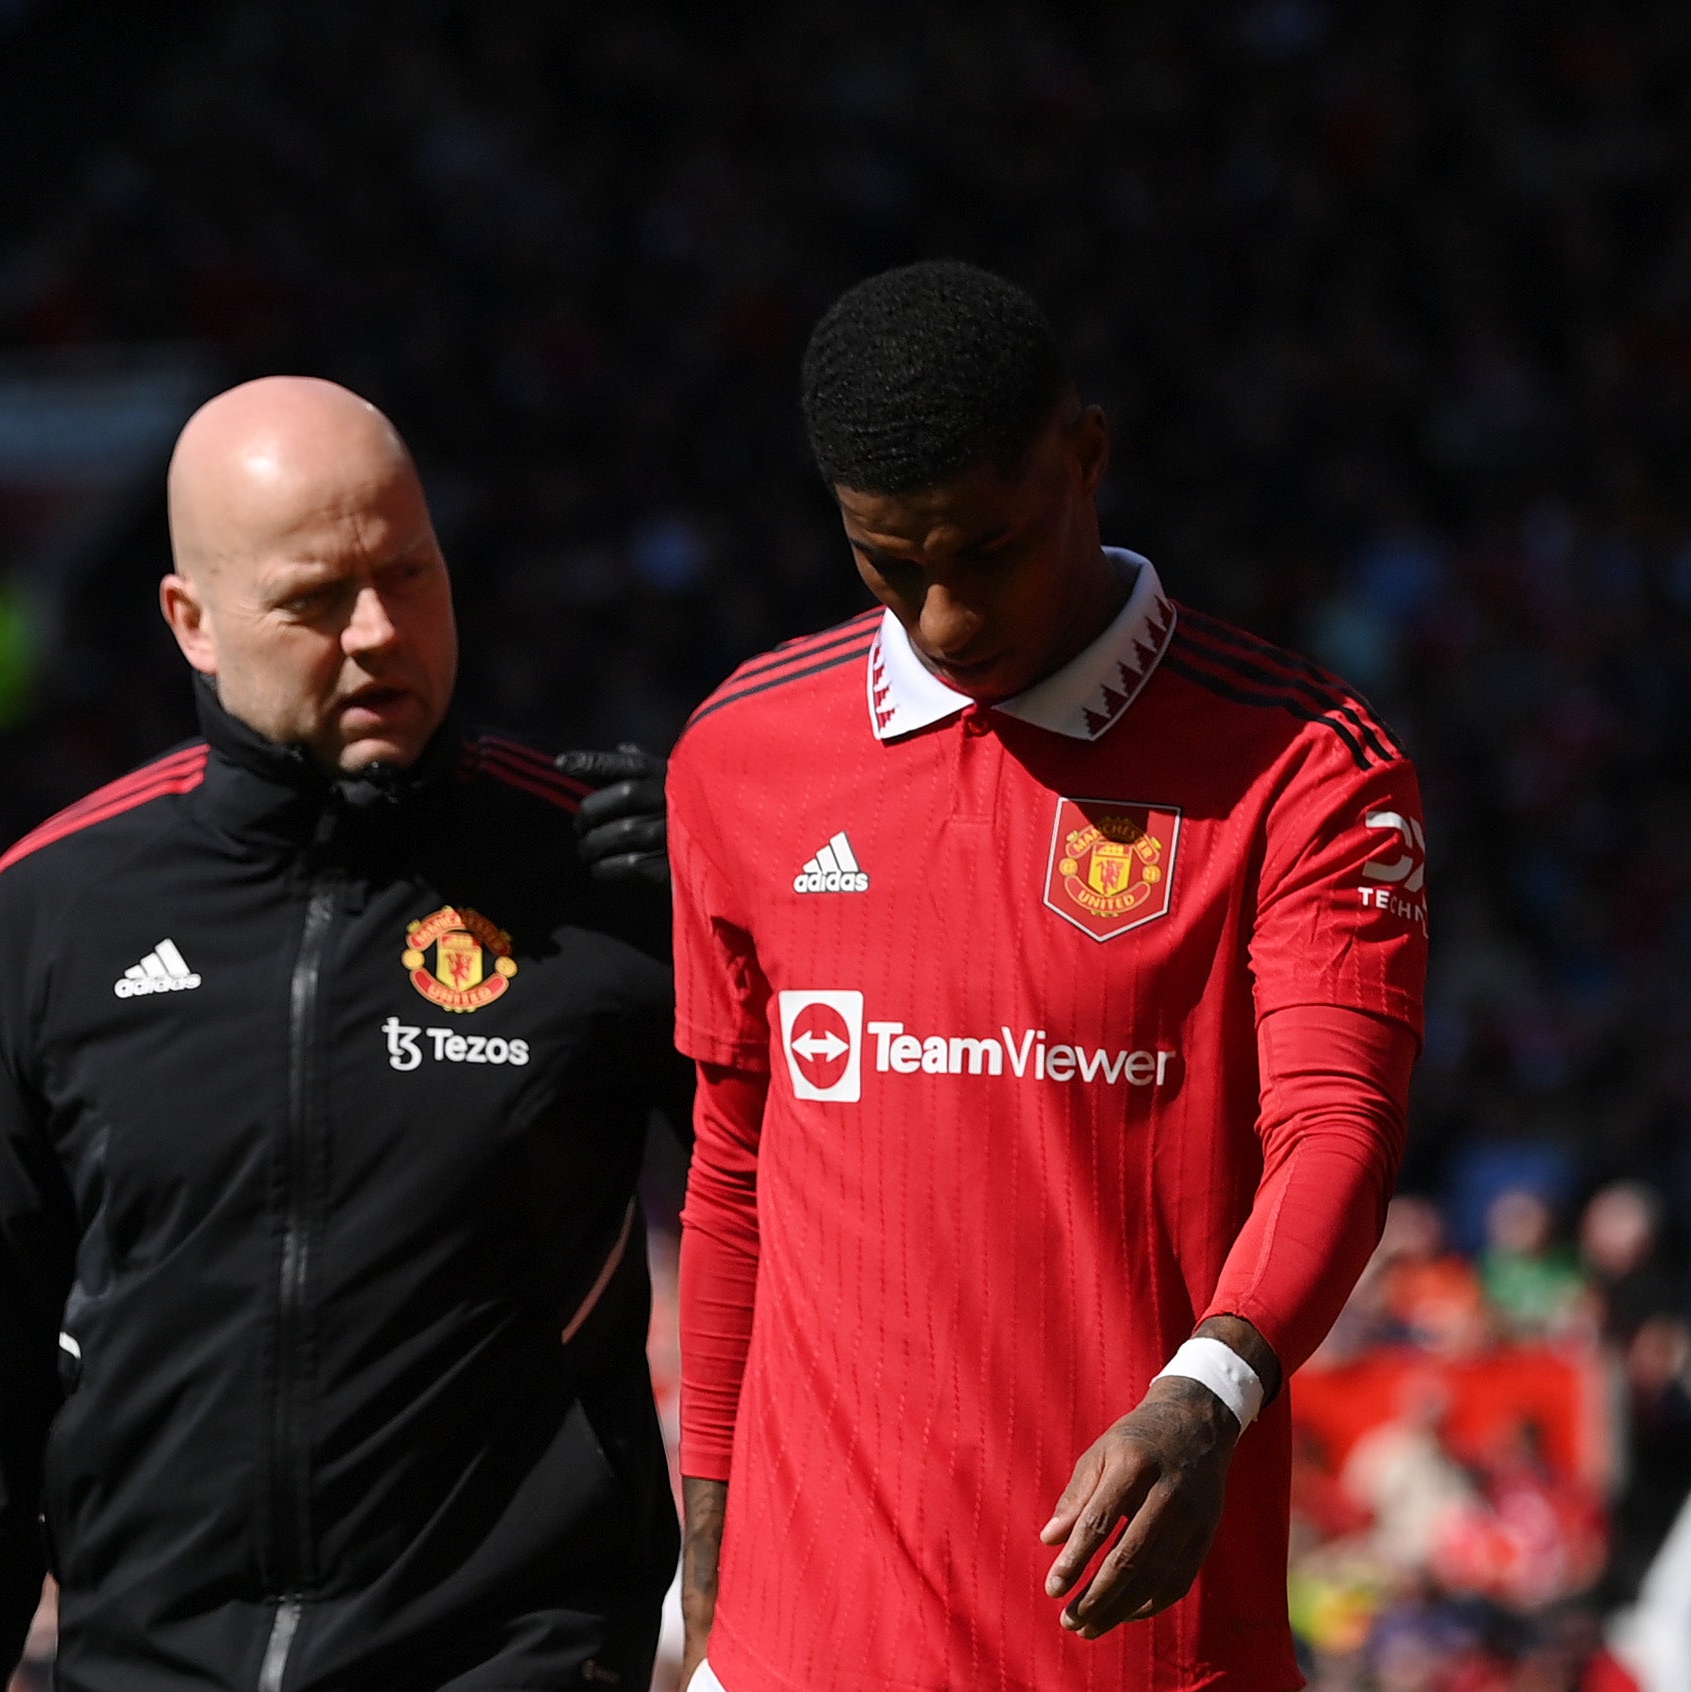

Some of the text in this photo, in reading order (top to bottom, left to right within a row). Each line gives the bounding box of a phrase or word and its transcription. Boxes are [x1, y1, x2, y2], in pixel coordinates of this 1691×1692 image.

[792, 869, 870, 894] adidas
[1077, 889, 1136, 910] UNITED
[114, 972, 202, 999] adidas
[426, 1027, 530, 1066] Tezos
[866, 1021, 1176, 1086] TeamViewer
